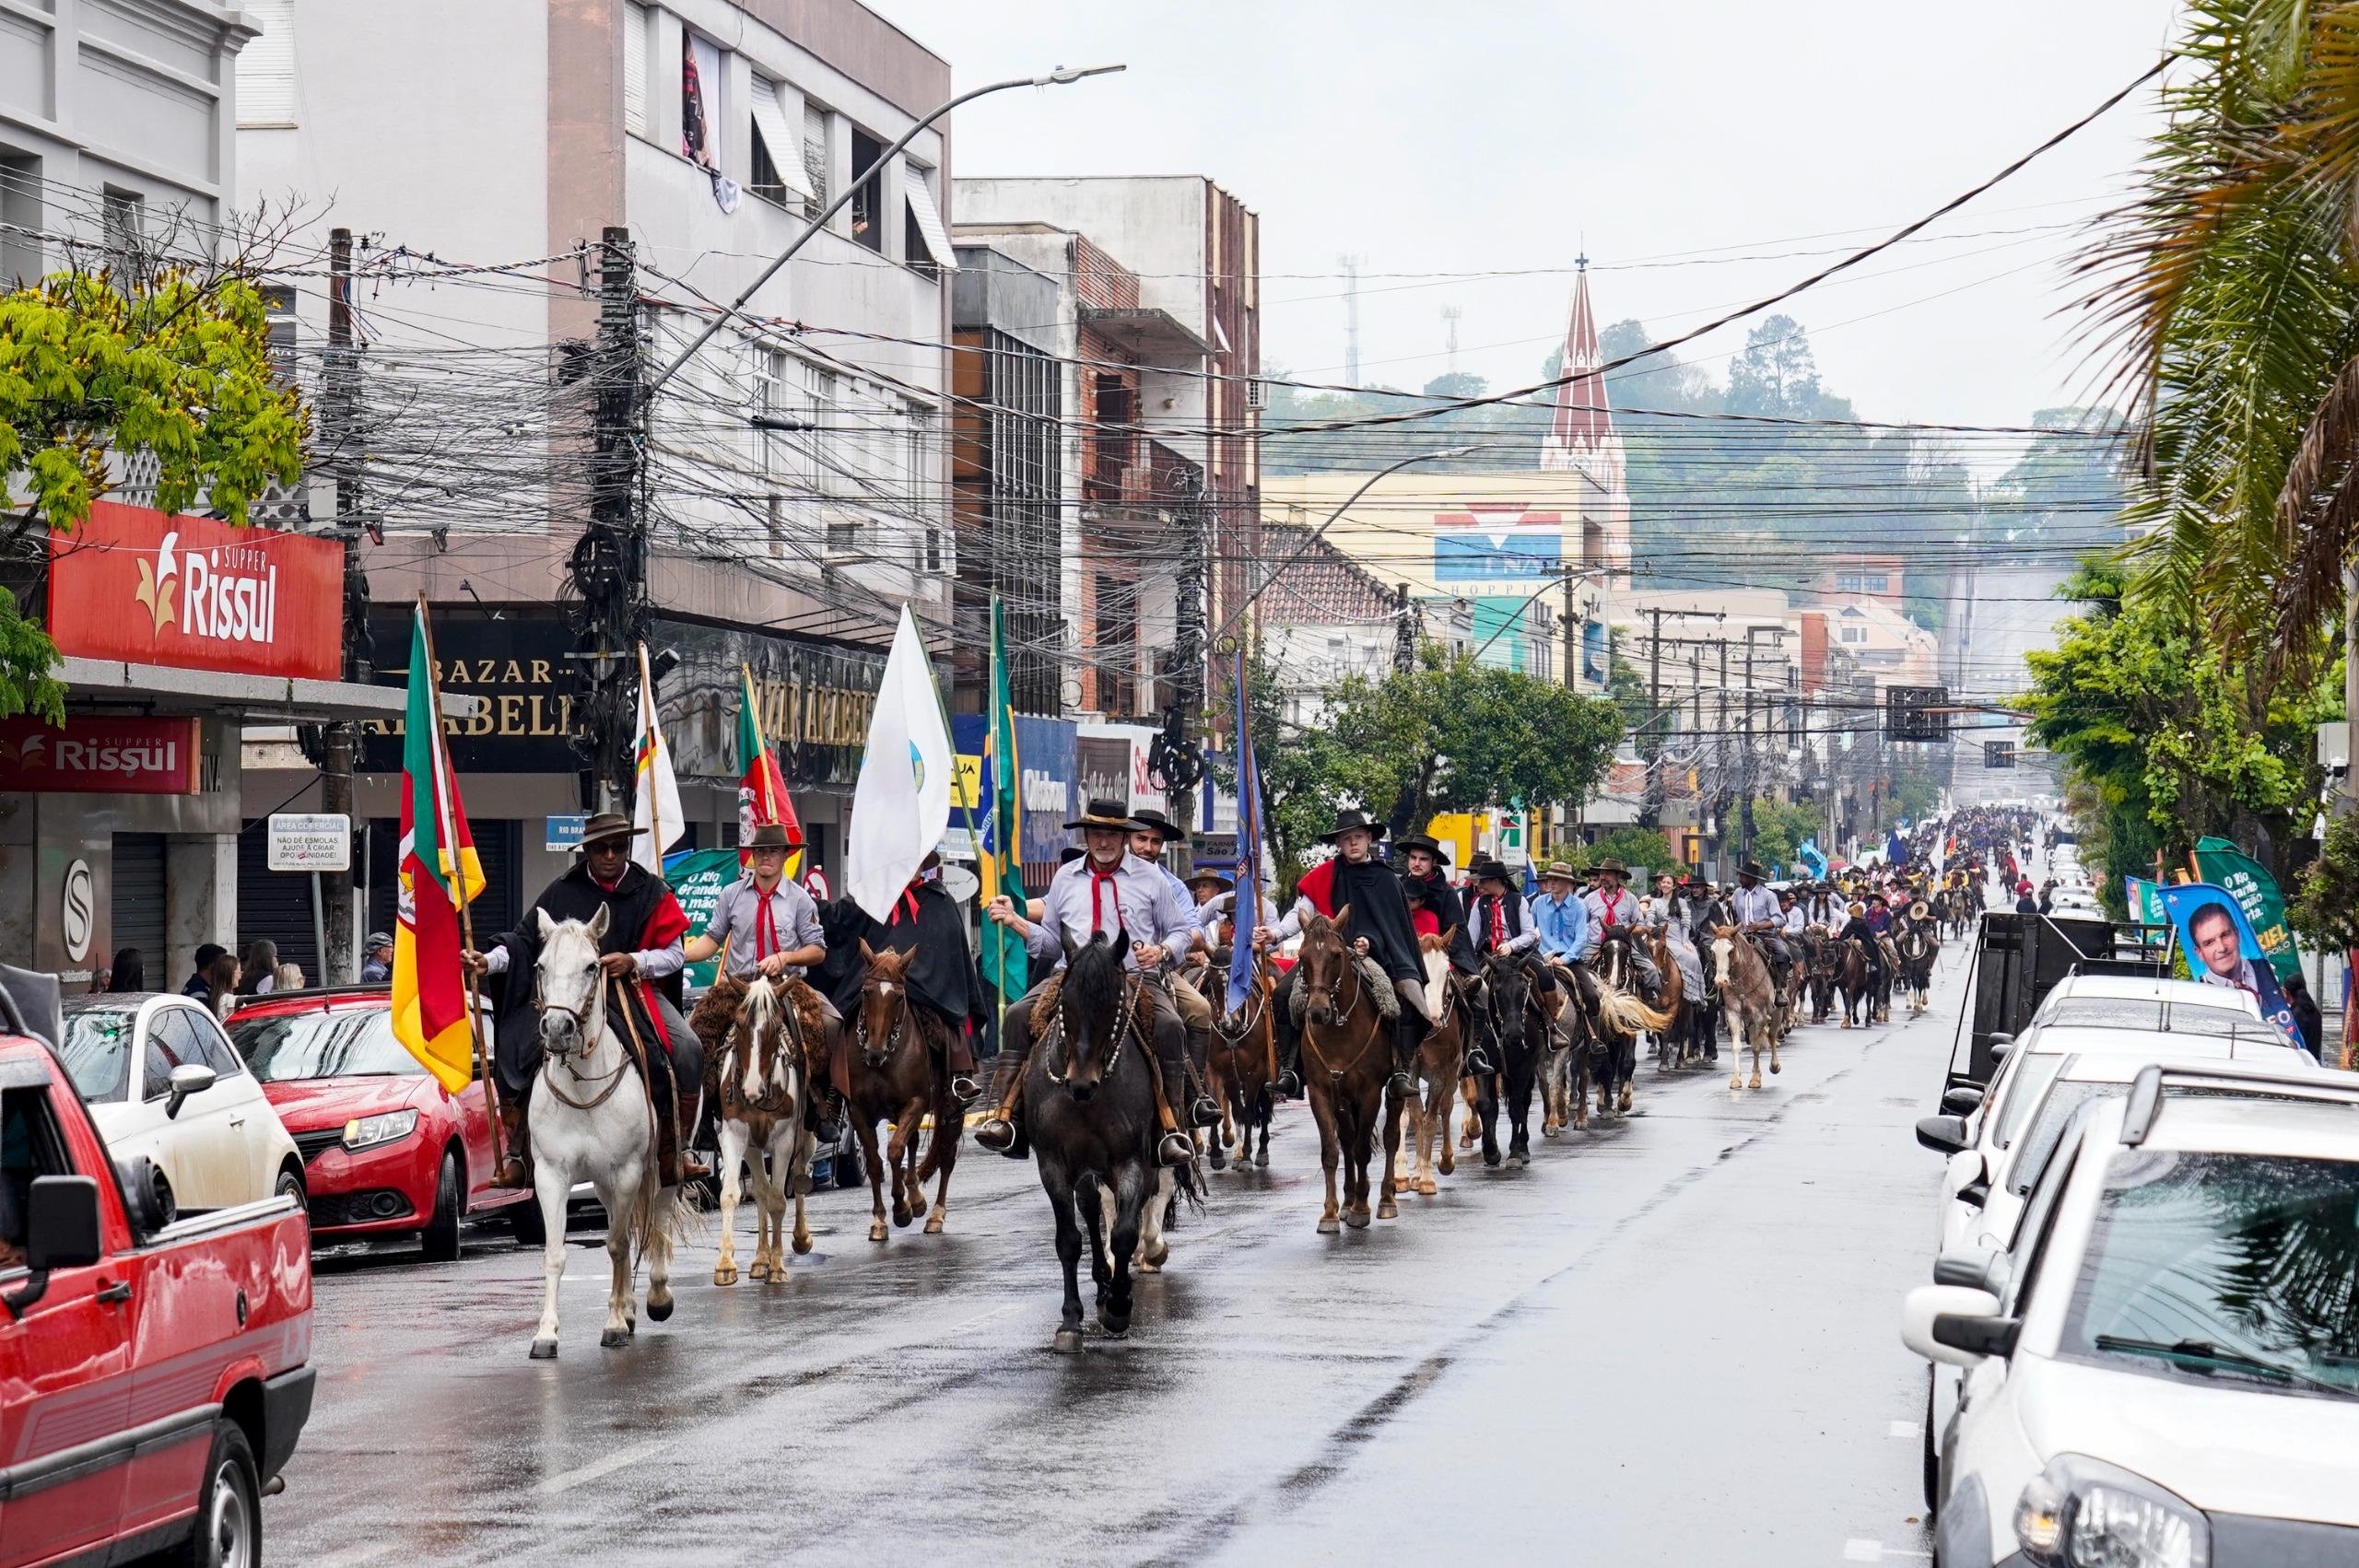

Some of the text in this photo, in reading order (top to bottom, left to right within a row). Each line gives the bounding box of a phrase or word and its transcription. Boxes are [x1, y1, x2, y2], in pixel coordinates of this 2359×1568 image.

[225, 546, 266, 573] SUPPER
[182, 548, 276, 644] Rissul
[105, 737, 162, 746] SUPPER
[55, 738, 176, 771] Rissul
[298, 822, 342, 830] COMERCIAL
[276, 836, 292, 844] NÃO
[687, 871, 721, 883] O Rio
[2224, 872, 2249, 888] O Rio
[677, 883, 722, 895] Grande
[2232, 881, 2259, 899] rande
[688, 896, 718, 909] mão
[2241, 893, 2263, 910] mão
